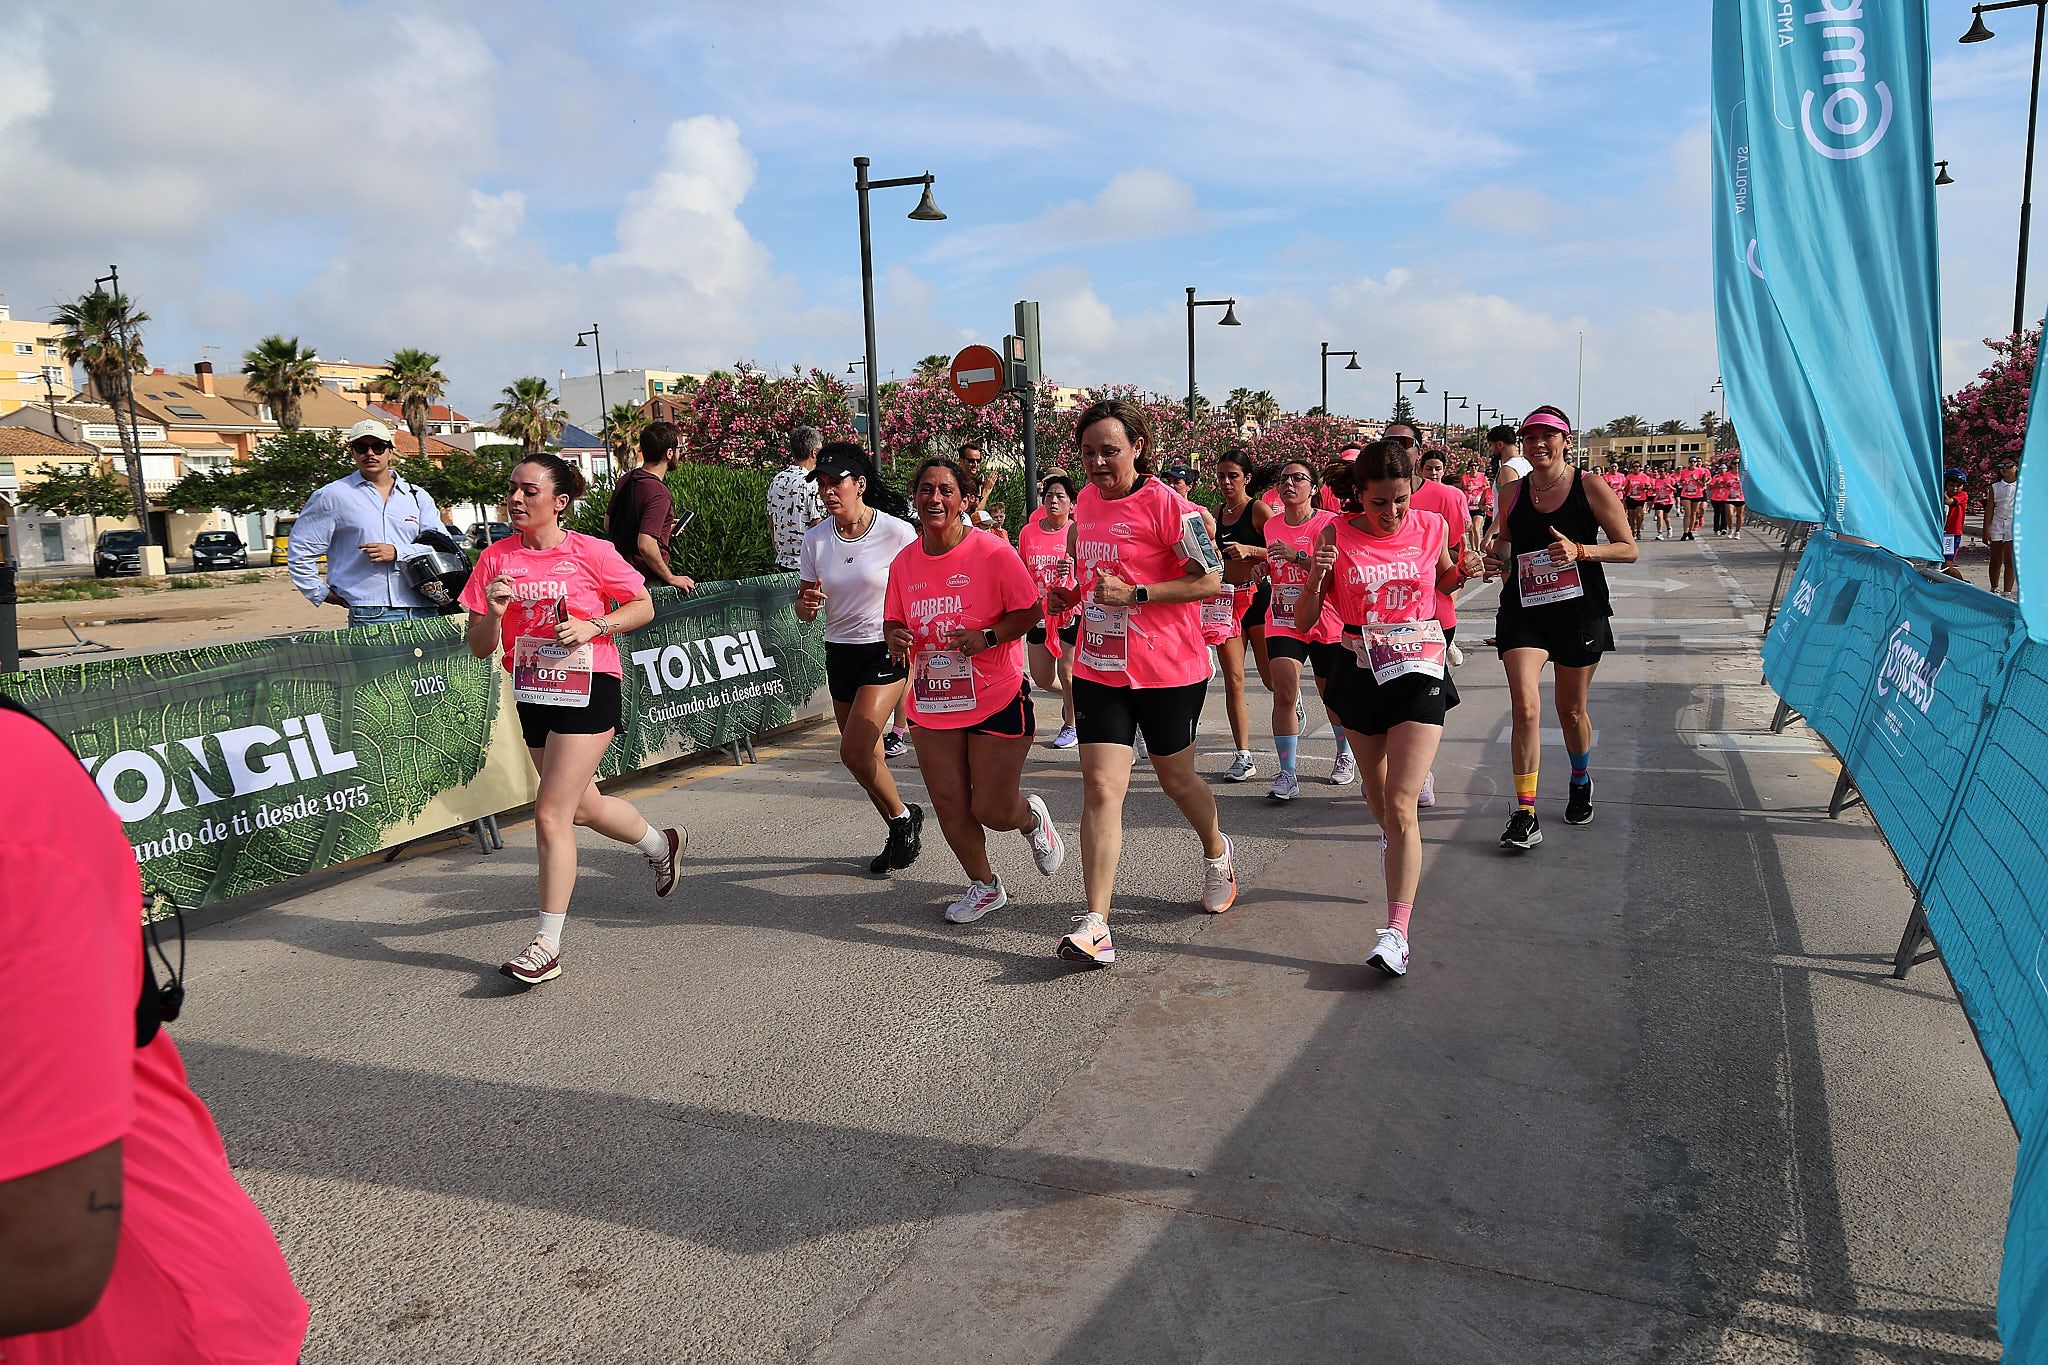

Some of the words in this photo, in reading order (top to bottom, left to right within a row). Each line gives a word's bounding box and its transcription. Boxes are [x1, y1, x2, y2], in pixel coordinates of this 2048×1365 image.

[1287, 566, 1302, 582] DE
[1348, 561, 1420, 584] CARRERA
[1535, 572, 1559, 585] 016
[510, 580, 568, 602] ARRERA
[1385, 586, 1408, 609] DE
[1283, 604, 1294, 612] 01
[1086, 631, 1104, 646] 016
[1392, 642, 1422, 653] 016
[538, 668, 567, 681] 016
[1382, 665, 1405, 678] OYSHO
[1878, 620, 1948, 713] Compeed
[411, 675, 446, 697] 2026
[928, 679, 951, 690] 016
[521, 692, 545, 701] OYSHO
[648, 695, 706, 723] Cuidando
[706, 692, 720, 708] de
[720, 688, 732, 704] ti
[732, 681, 762, 701] desde
[762, 678, 784, 696] 1975
[80, 712, 358, 823] ONGiL
[199, 814, 229, 845] de
[232, 809, 252, 837] ti
[254, 798, 319, 830] desde
[322, 784, 370, 814] 1975
